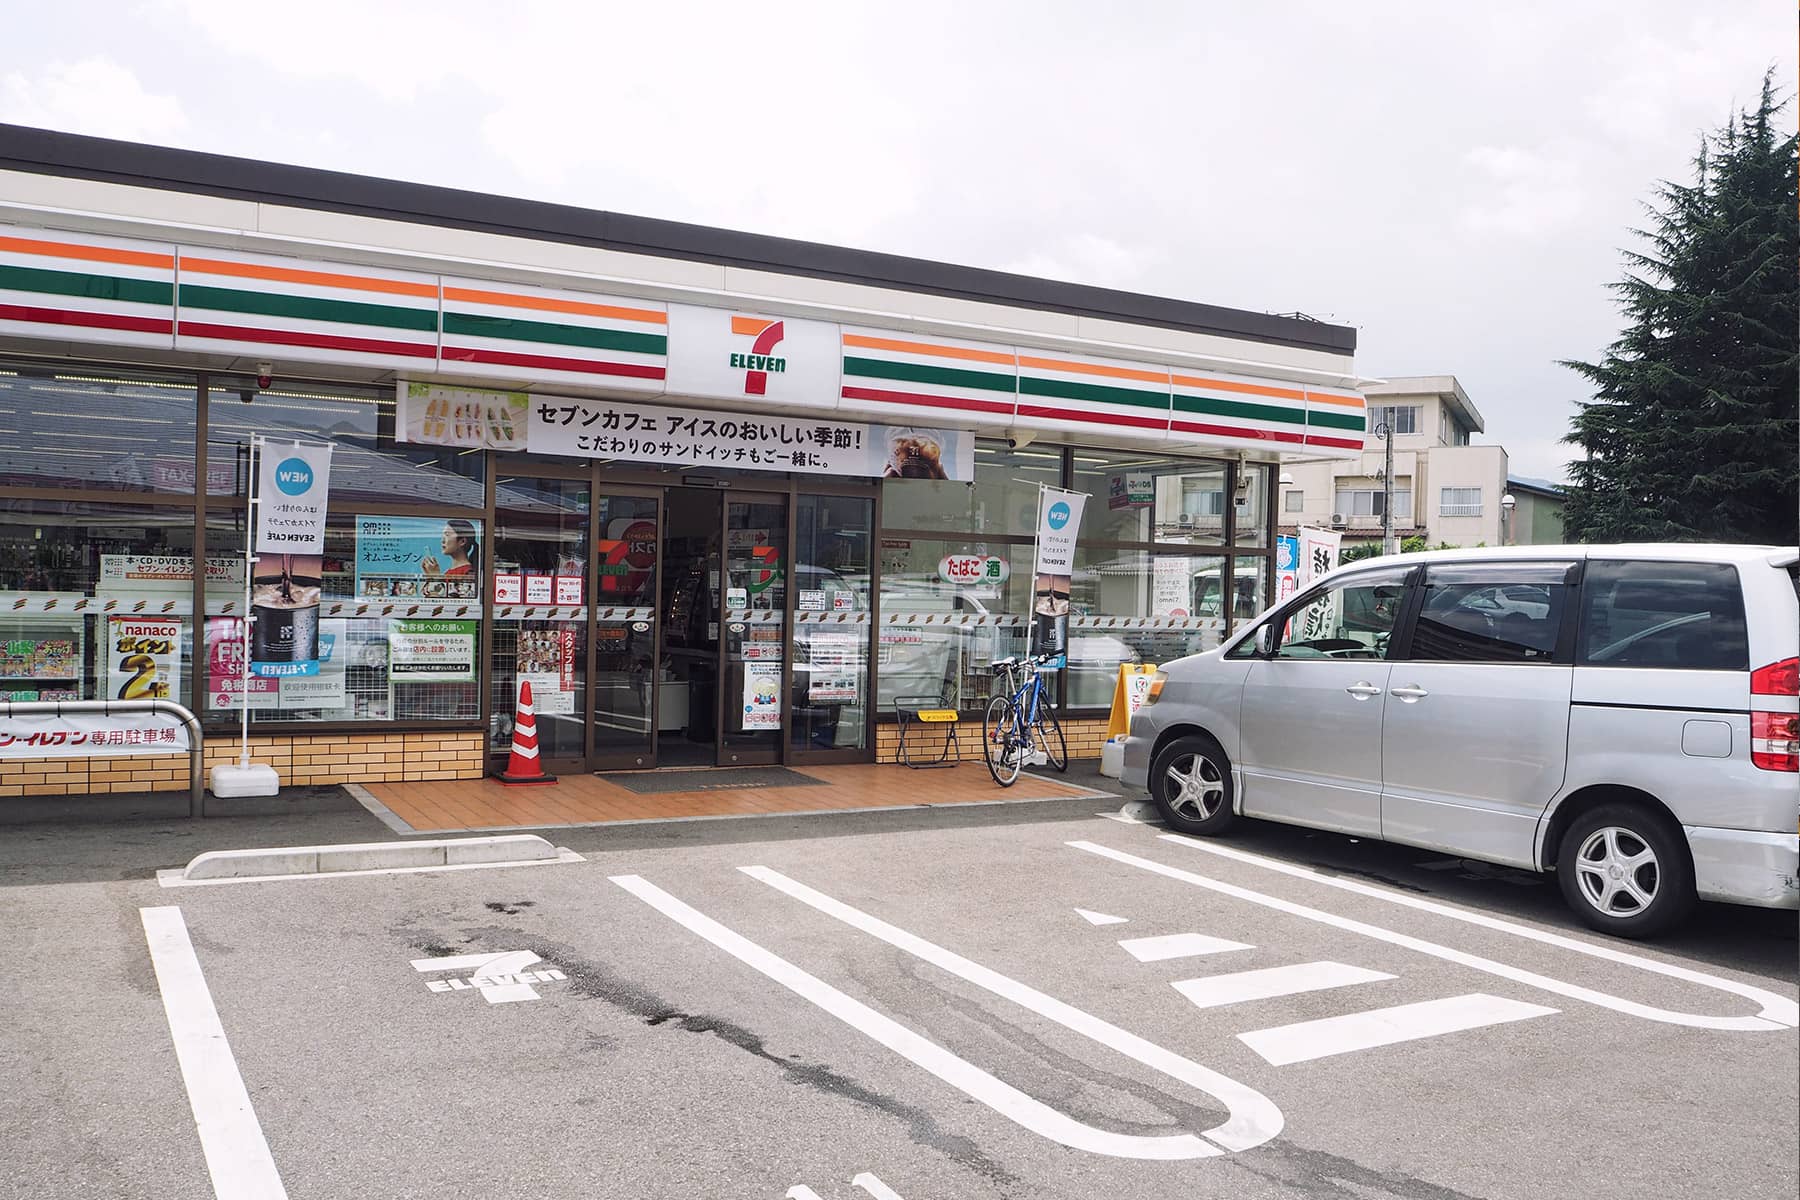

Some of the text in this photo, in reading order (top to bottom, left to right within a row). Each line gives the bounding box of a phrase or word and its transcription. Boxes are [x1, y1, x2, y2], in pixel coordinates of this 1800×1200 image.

[731, 316, 784, 395] 7
[537, 403, 657, 432] セブンカフェ
[577, 435, 829, 468] こだわりのサンドイッチもご一緒に。
[362, 552, 423, 563] オムニセブン
[947, 558, 1001, 577] たばこ 酒
[125, 625, 177, 637] nanaco
[116, 637, 176, 654] ポイント
[90, 727, 177, 746] 専用駐車場
